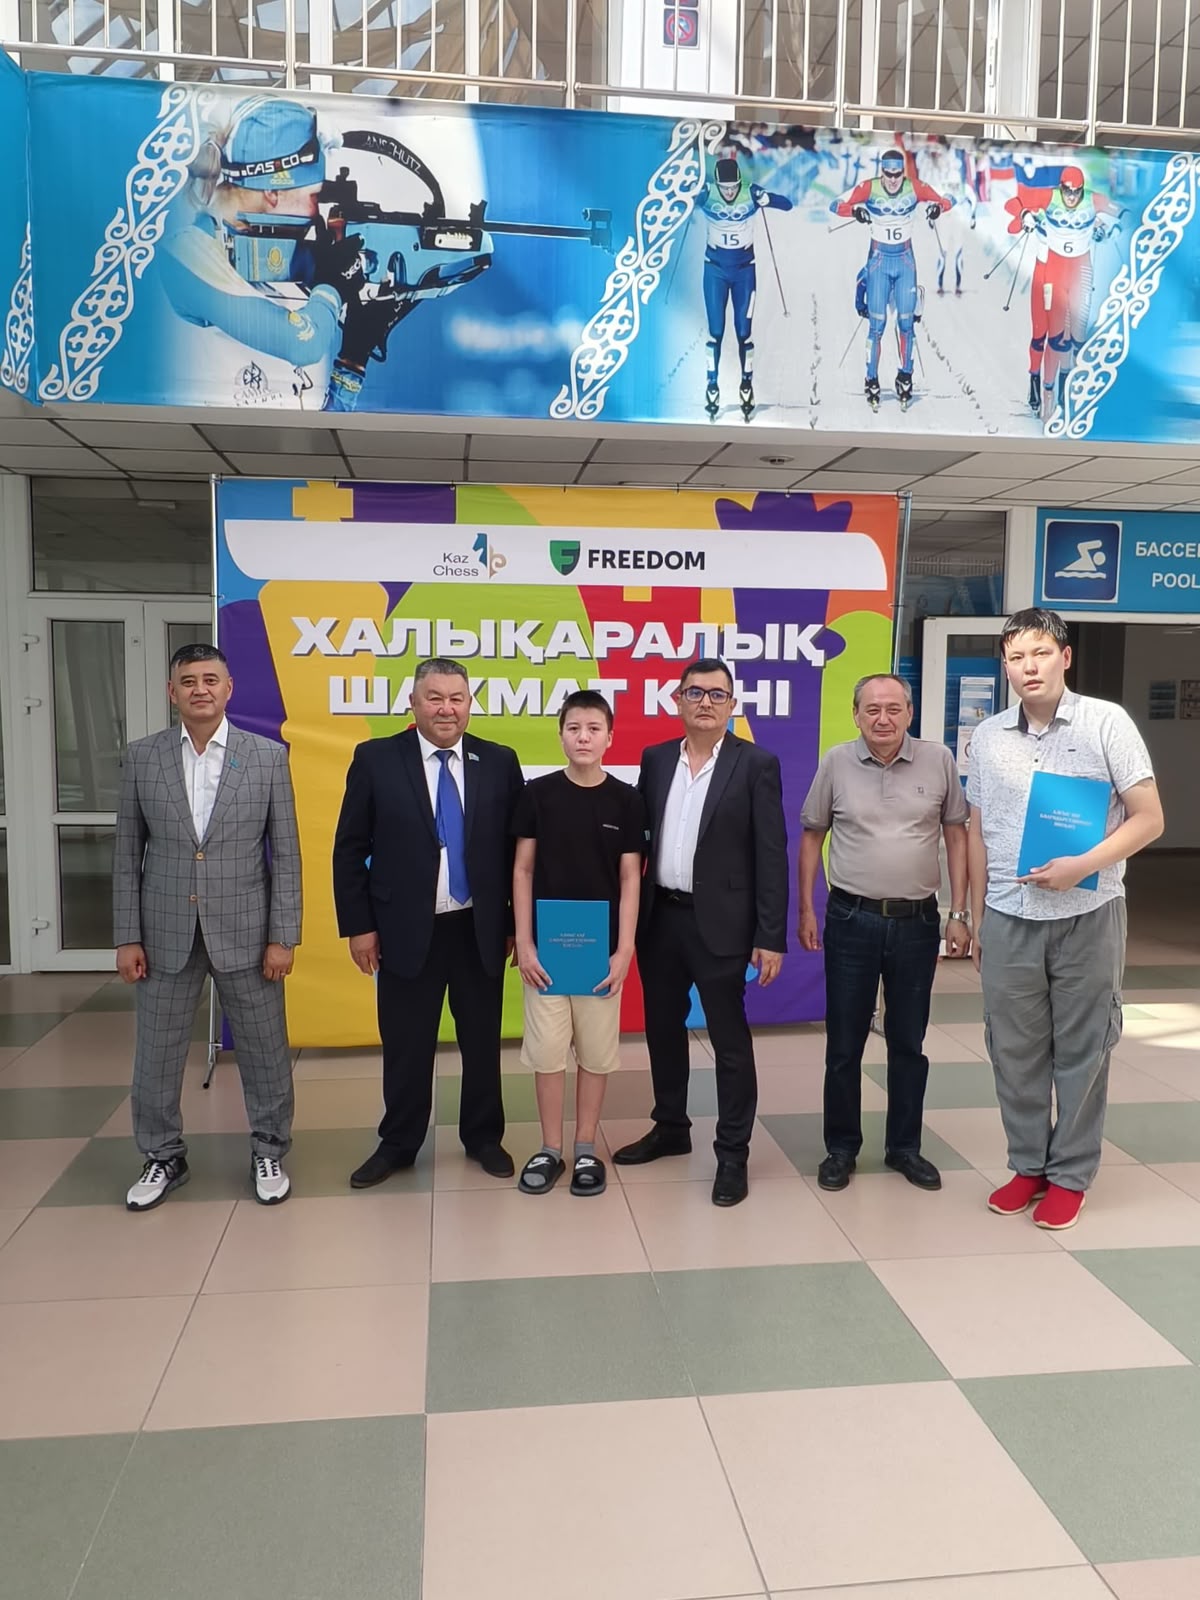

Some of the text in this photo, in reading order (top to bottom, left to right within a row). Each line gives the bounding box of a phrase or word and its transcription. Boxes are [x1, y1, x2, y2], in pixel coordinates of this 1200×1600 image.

[720, 232, 740, 246] 15
[884, 226, 904, 241] 16
[1063, 241, 1074, 254] 6
[443, 552, 469, 563] Kaz
[1135, 541, 1200, 558] БАССЕ
[588, 549, 706, 571] FREEDOM
[432, 564, 479, 577] Chess
[1151, 572, 1200, 589] POOL
[291, 616, 827, 667] ХАЛЫҚАРАЛЫҚ
[643, 679, 791, 717] КНІ
